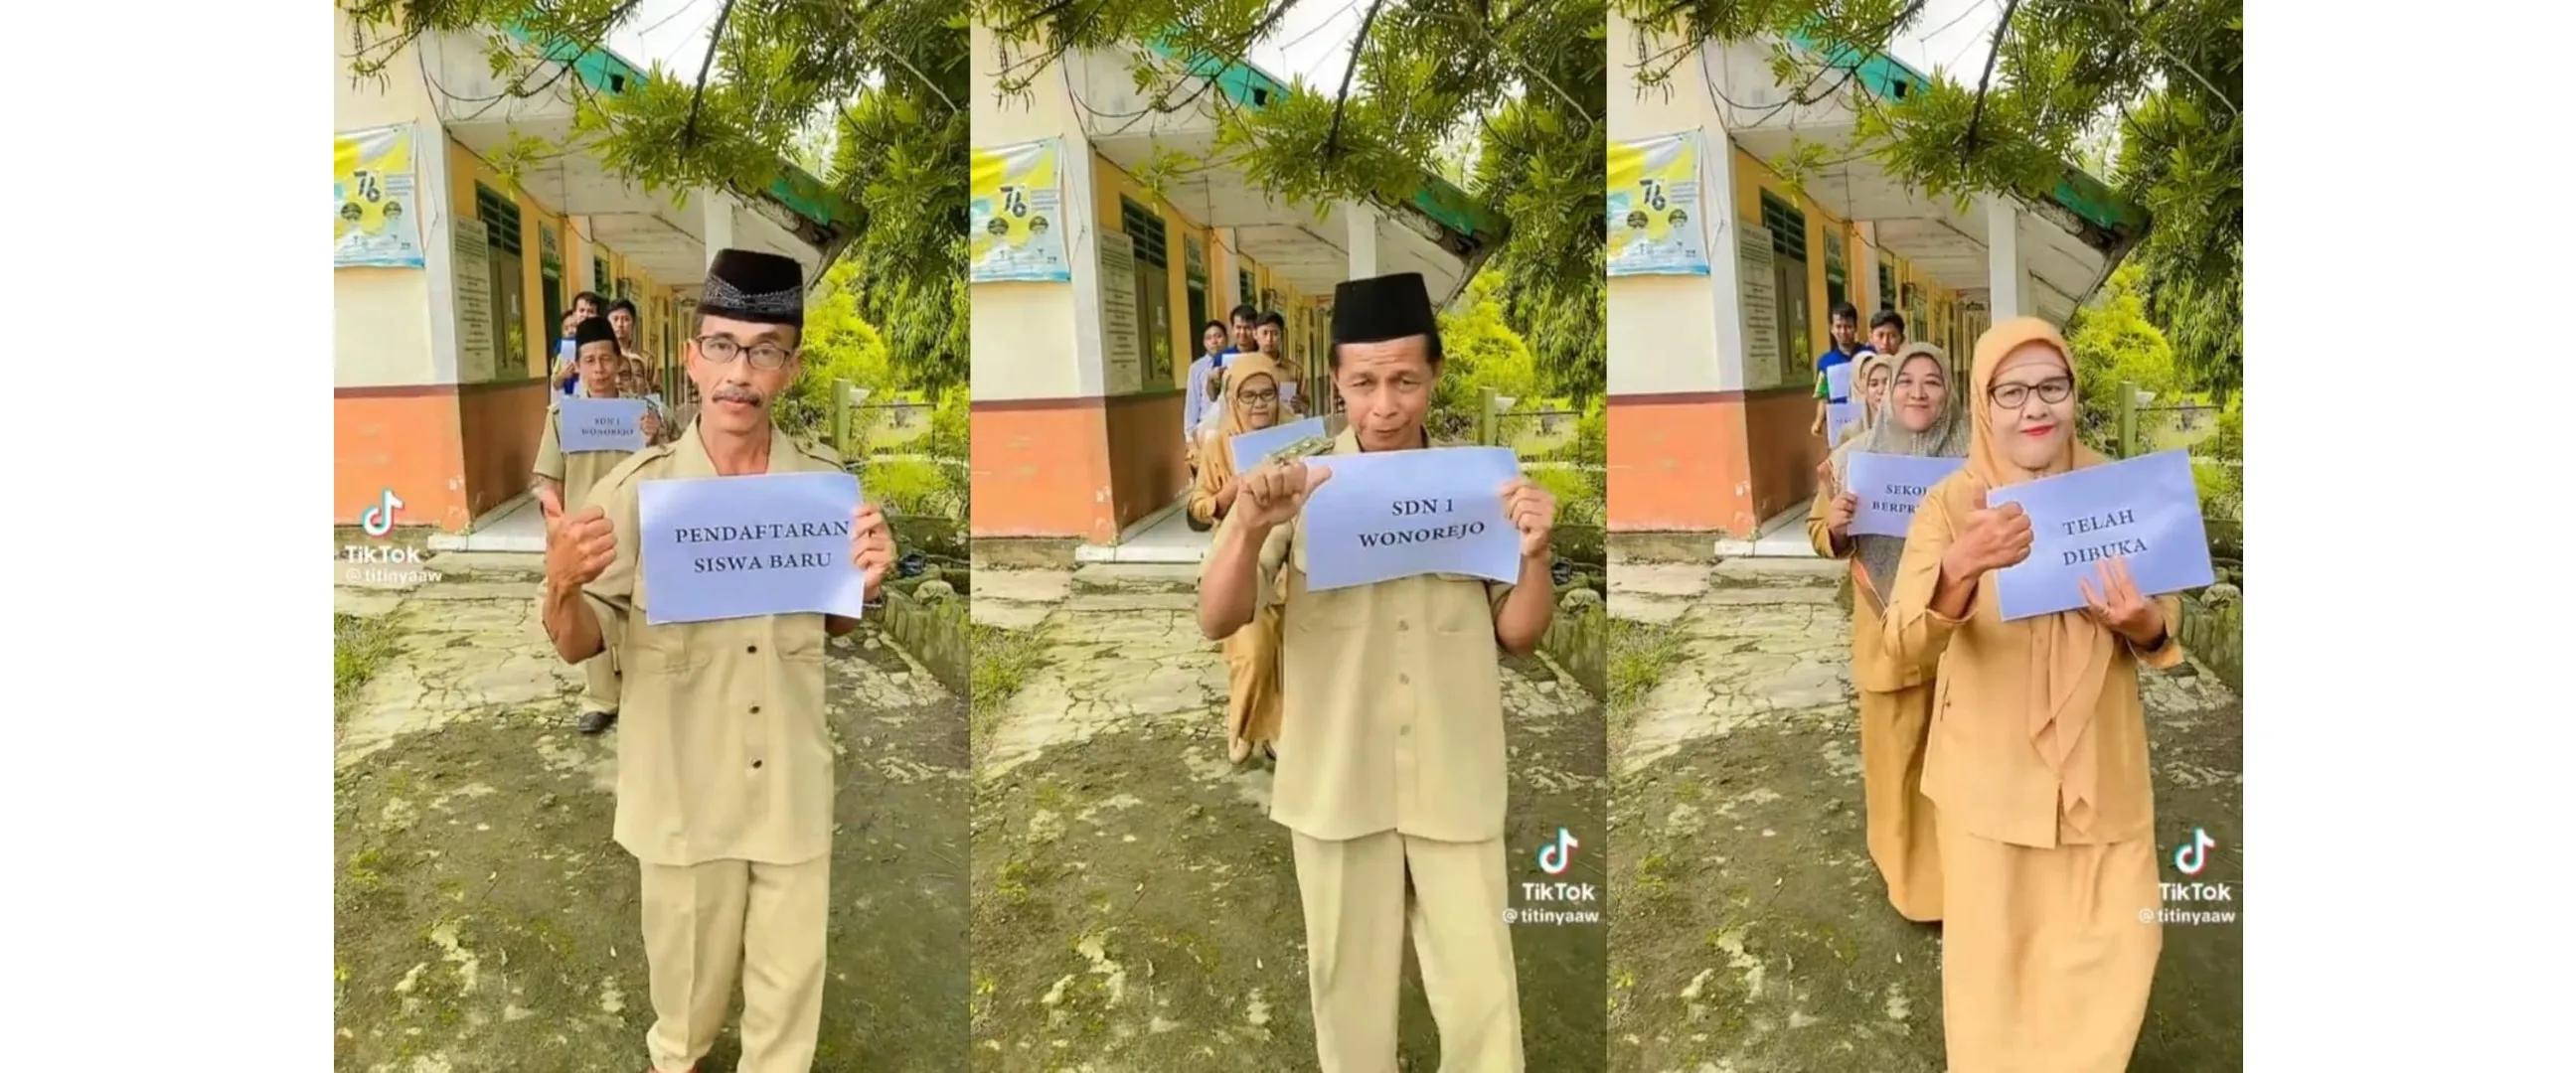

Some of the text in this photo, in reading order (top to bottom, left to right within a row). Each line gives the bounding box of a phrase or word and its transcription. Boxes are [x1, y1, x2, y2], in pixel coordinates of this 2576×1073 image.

[353, 170, 381, 203] 76
[1640, 179, 1666, 211] 76
[1000, 186, 1027, 218] 76
[1392, 498, 1454, 516] SDN 1
[1872, 500, 1919, 514] BERPR
[676, 520, 850, 543] PENDAFTARAN
[1358, 521, 1485, 547] WONOREJO
[2062, 509, 2135, 536] TELAH
[695, 551, 833, 573] SISWA BARU
[2063, 537, 2148, 566] DIBUKA
